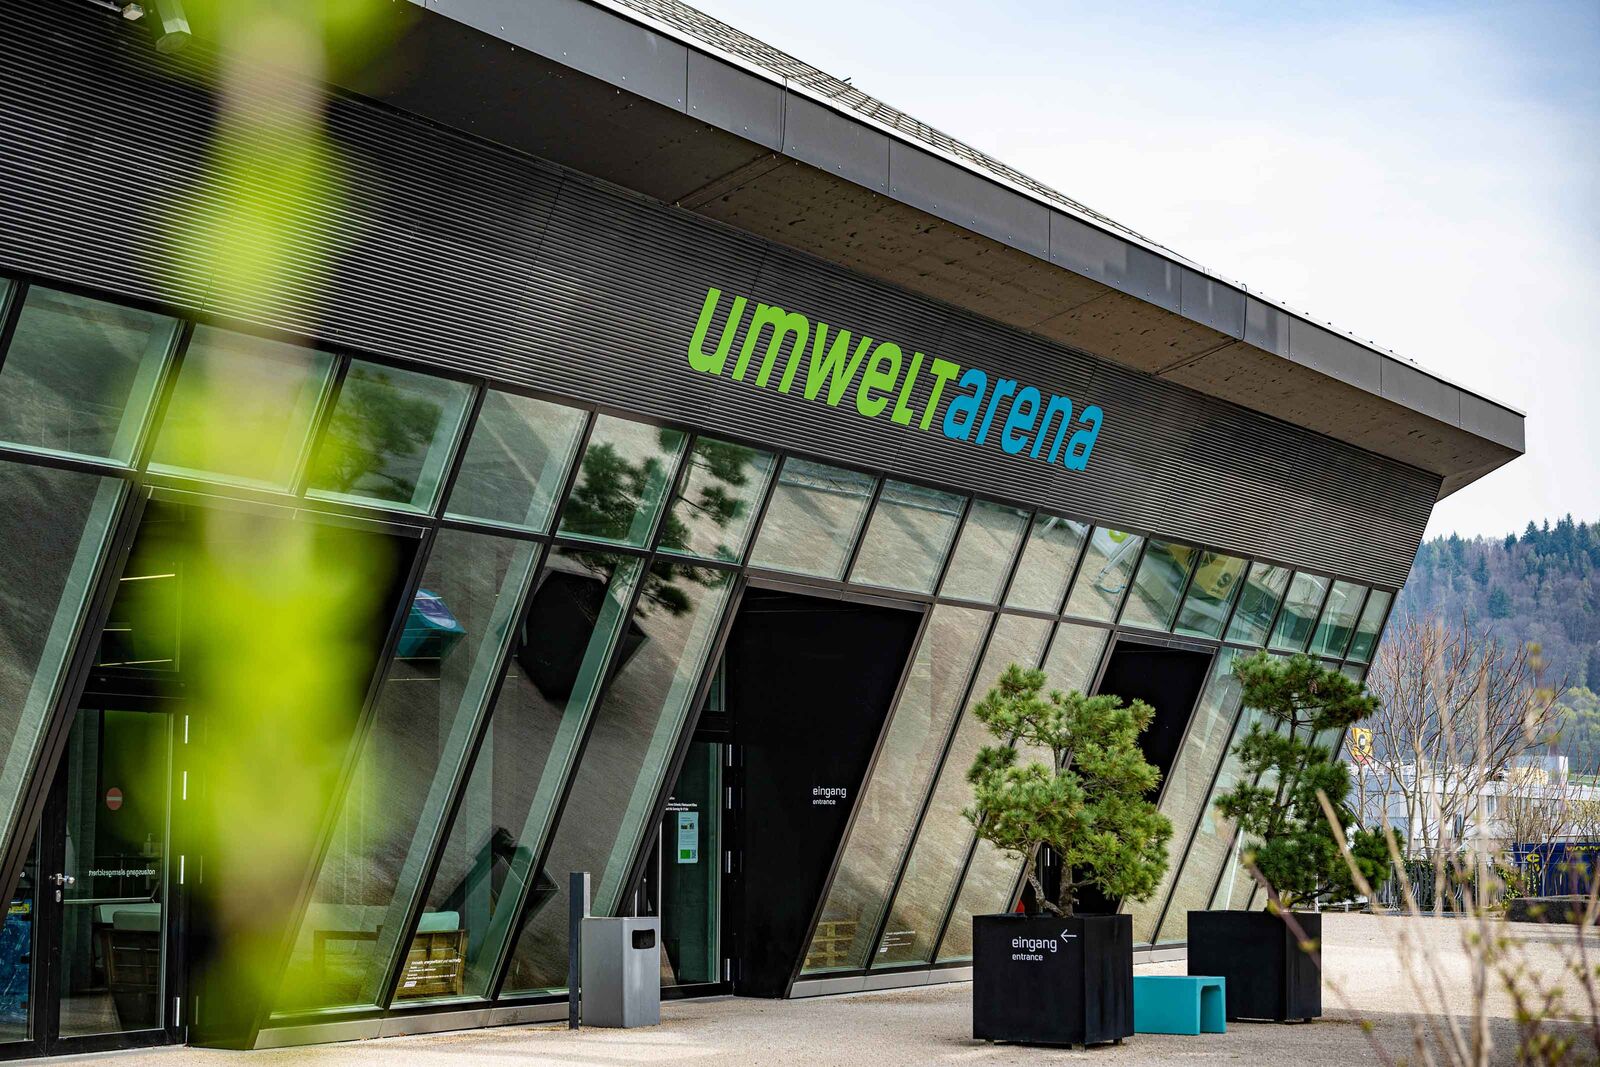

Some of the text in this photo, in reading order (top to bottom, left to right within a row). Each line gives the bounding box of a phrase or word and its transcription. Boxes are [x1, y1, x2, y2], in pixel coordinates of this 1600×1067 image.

[812, 786, 847, 799] eingang
[1011, 936, 1057, 953] eingang
[1011, 953, 1044, 961] entrance
